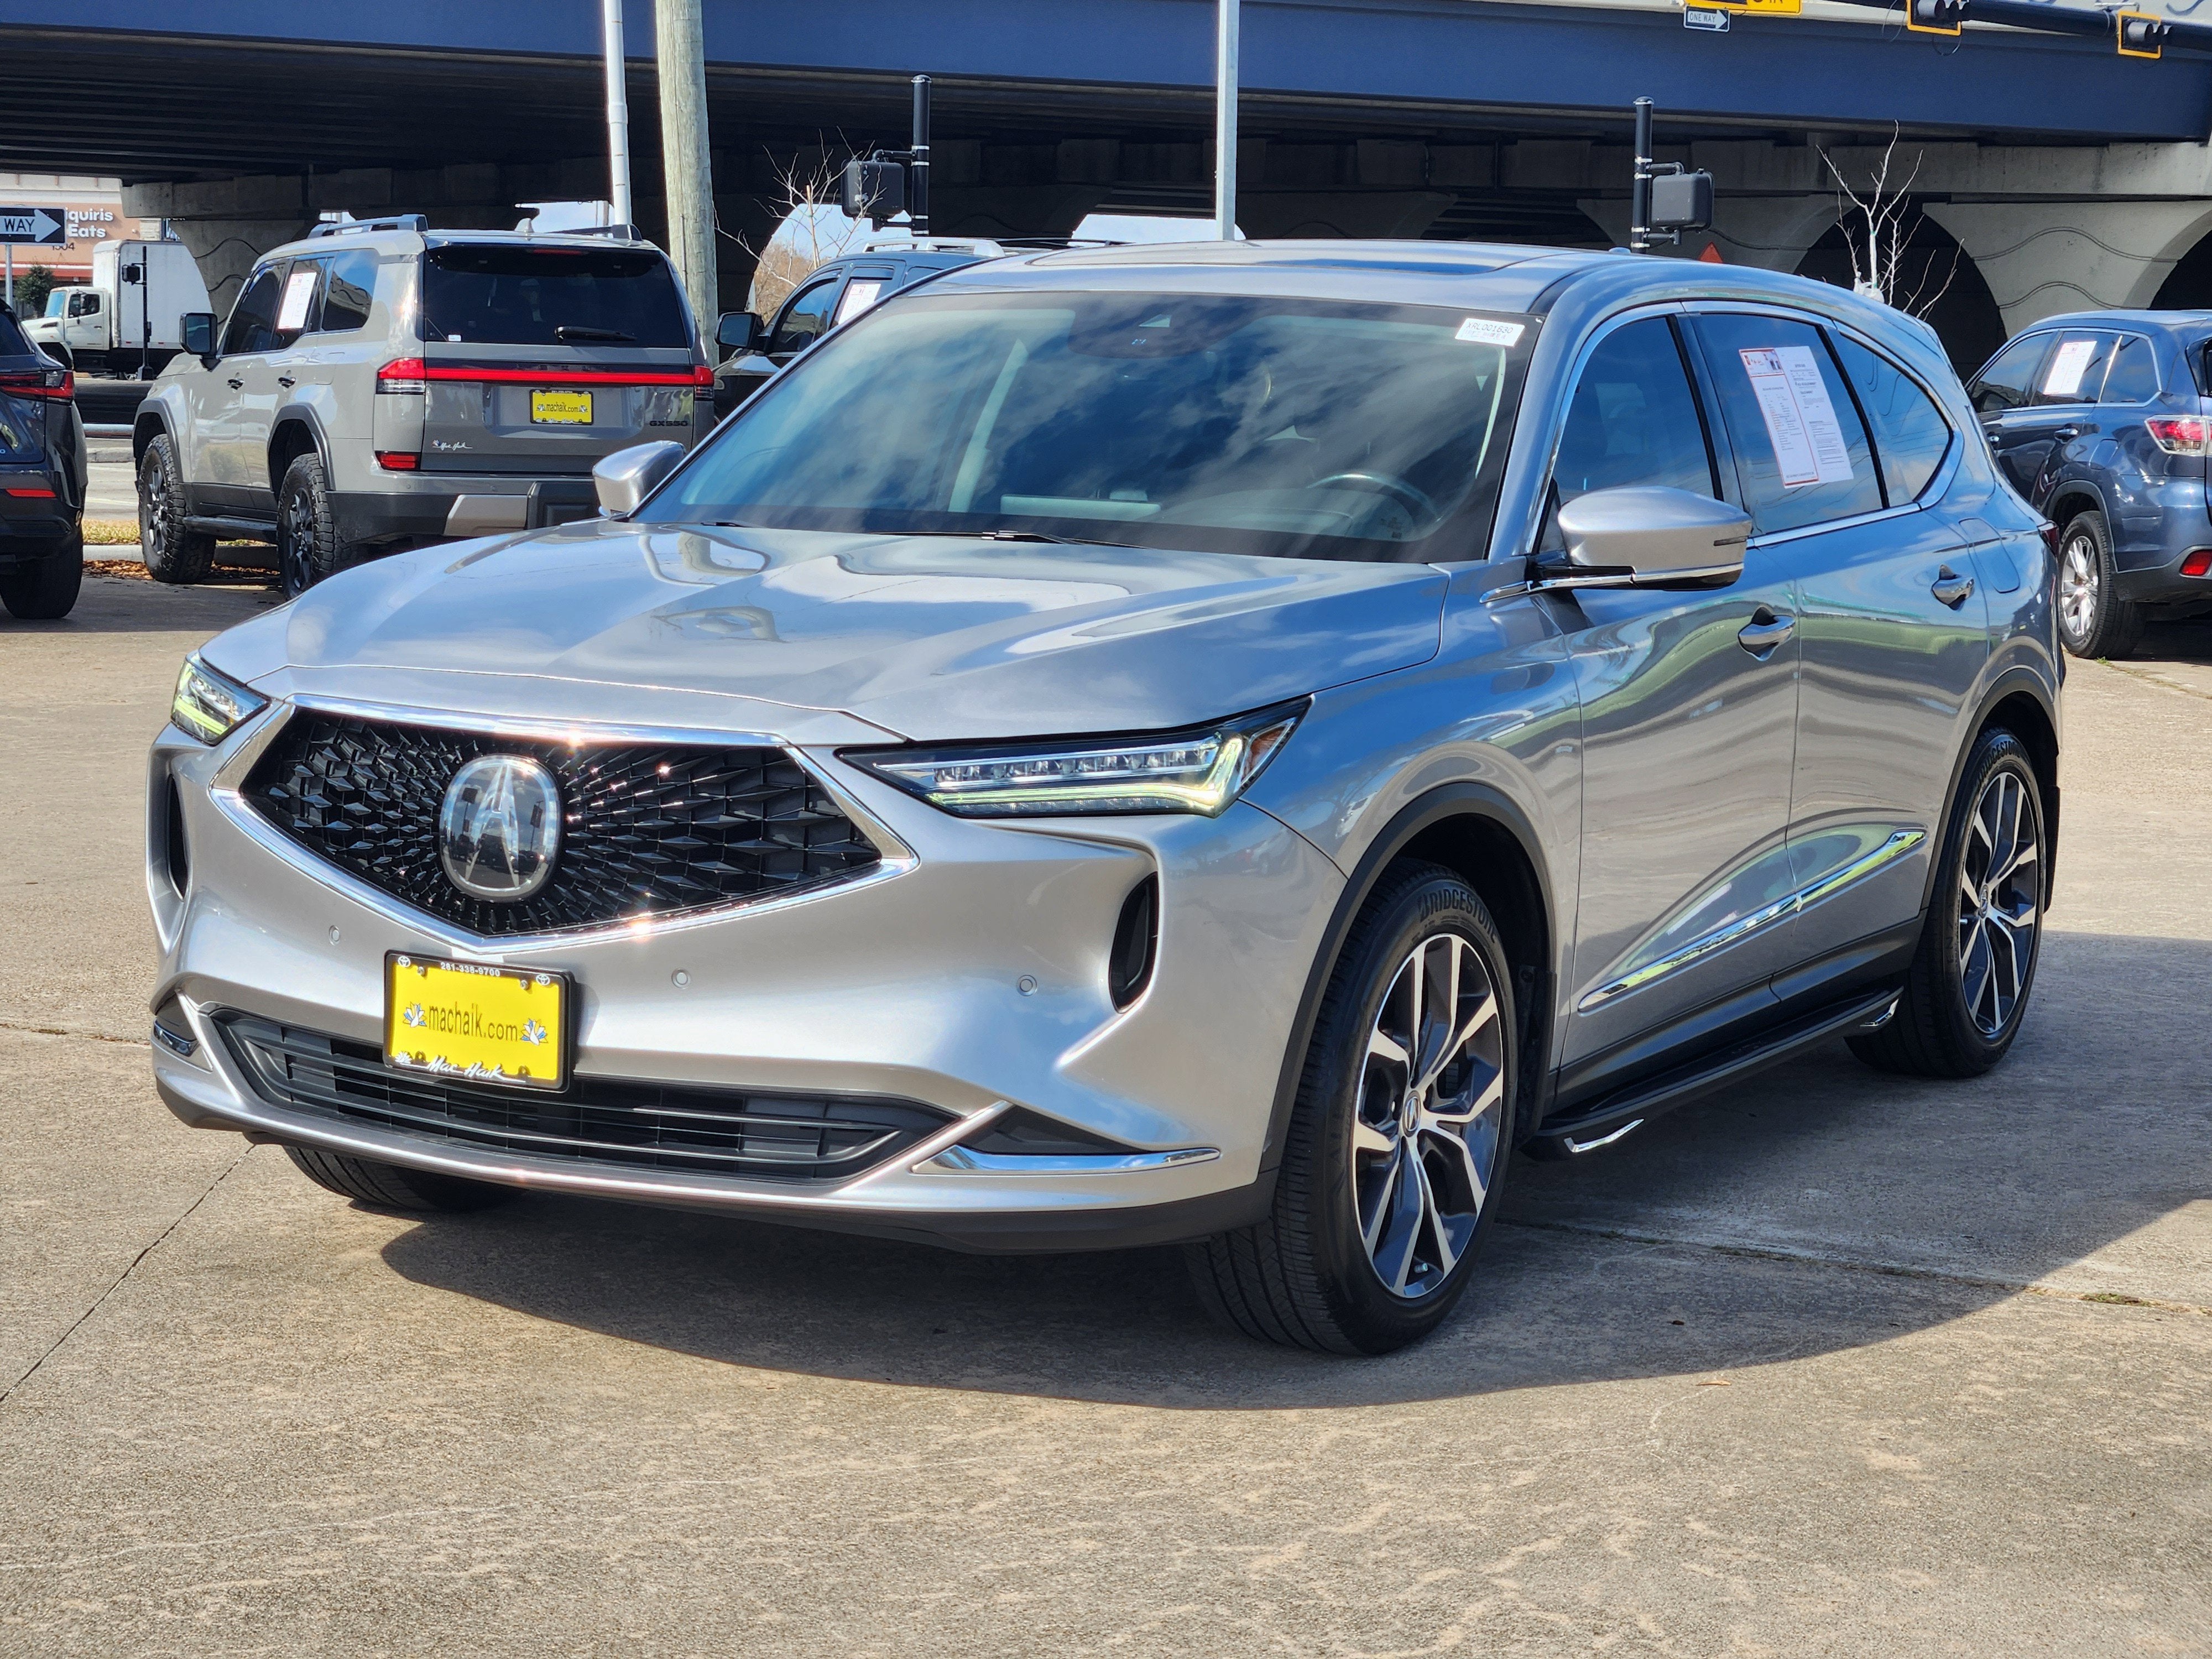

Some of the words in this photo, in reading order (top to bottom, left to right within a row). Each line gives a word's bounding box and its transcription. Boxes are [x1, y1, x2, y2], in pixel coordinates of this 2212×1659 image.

[1689, 12, 1702, 22] ONE
[1703, 14, 1716, 23] WAY
[4, 218, 35, 232] WAY
[67, 223, 107, 238] Eats
[441, 962, 500, 977] 281-338-9700
[429, 1001, 518, 1041] machaik.com
[427, 1054, 463, 1073] Mac
[463, 1060, 520, 1082] Haik
